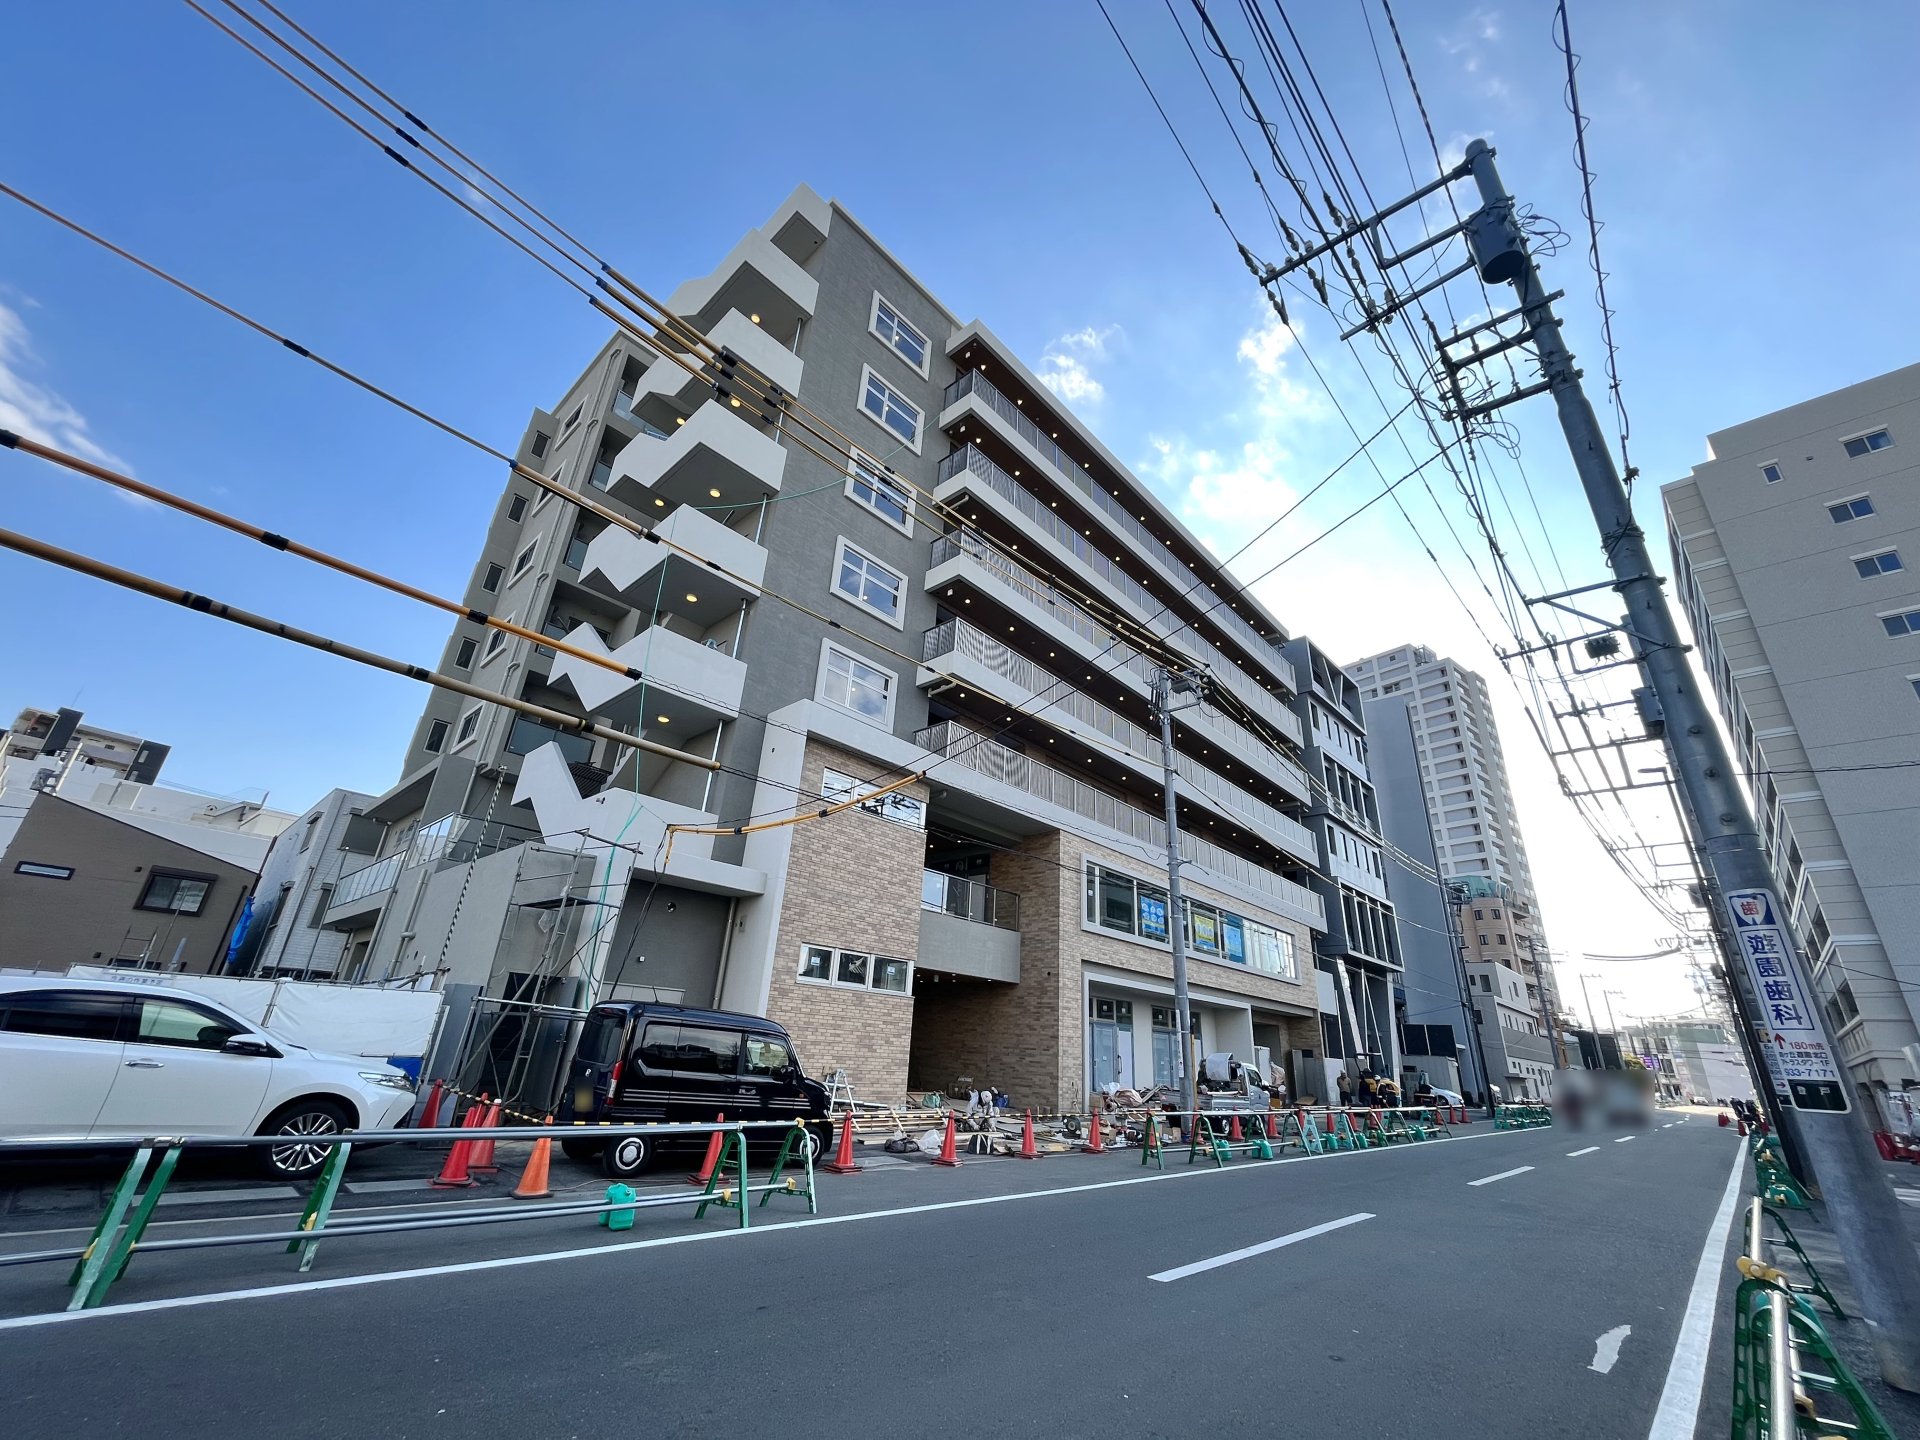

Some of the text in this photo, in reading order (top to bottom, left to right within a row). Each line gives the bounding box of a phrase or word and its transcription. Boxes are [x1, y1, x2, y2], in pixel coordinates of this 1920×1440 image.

[1740, 901, 1760, 916] 歯
[1746, 933, 1803, 1026] 遊園歯科
